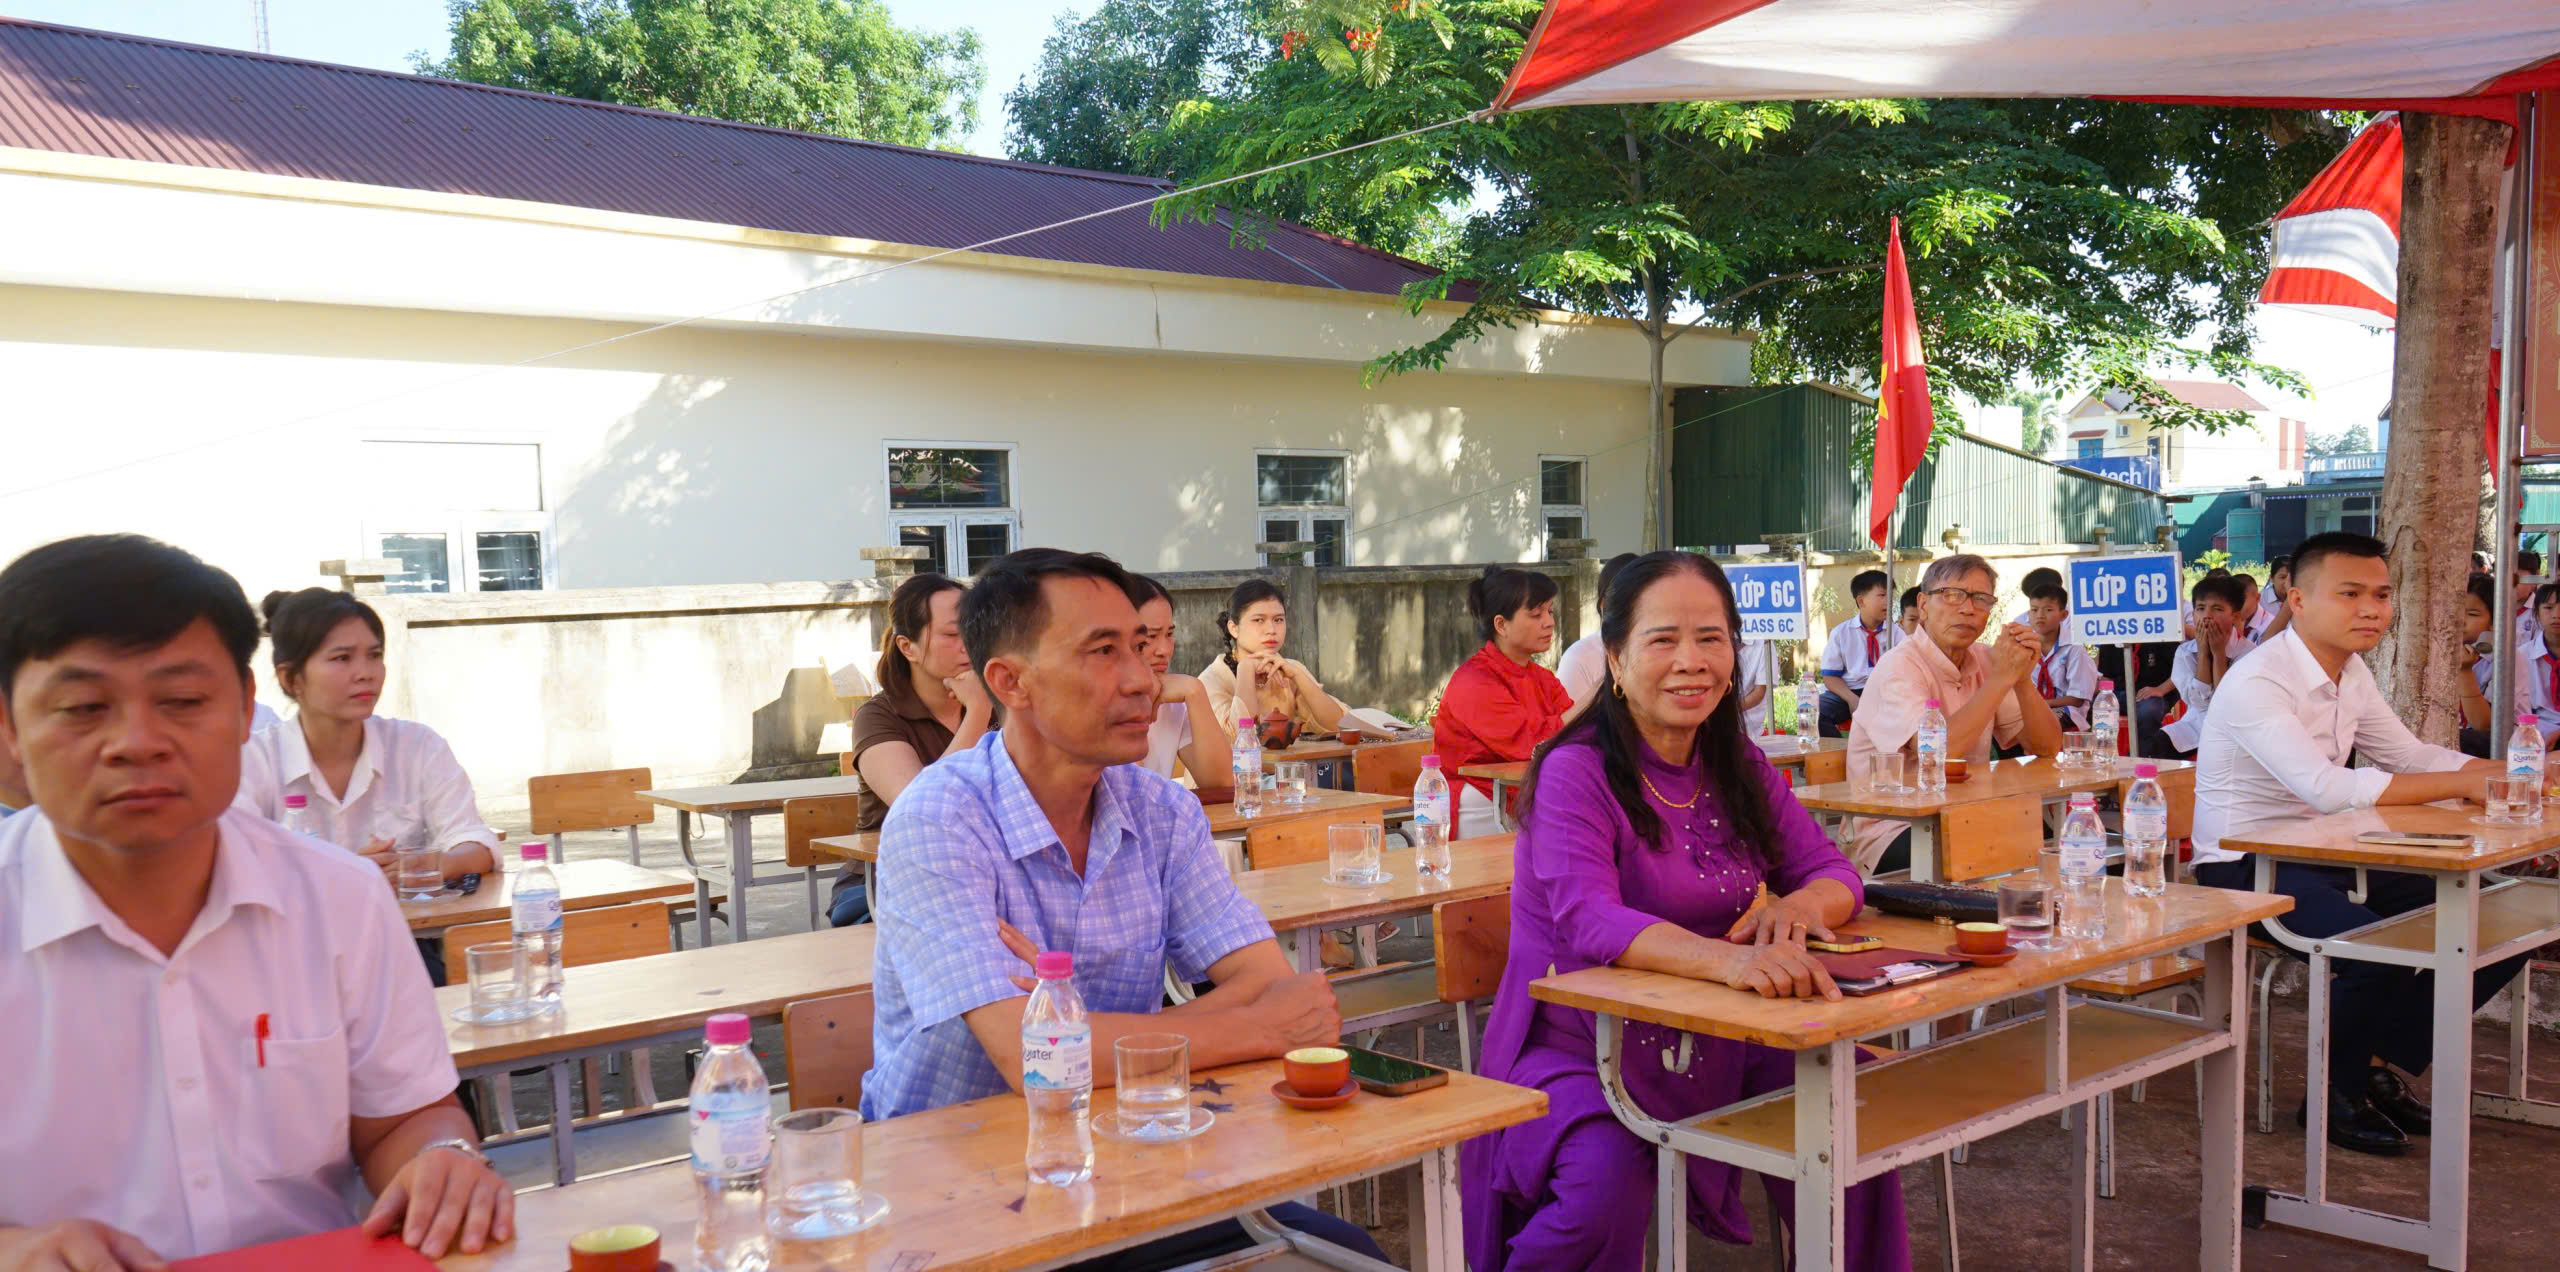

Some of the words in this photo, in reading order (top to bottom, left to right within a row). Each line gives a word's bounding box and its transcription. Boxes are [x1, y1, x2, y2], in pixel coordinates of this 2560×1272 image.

[1771, 580, 1796, 608] 6C
[2080, 567, 2127, 608] LỚP
[2134, 573, 2168, 606] 6B
[1741, 618, 1775, 633] LASS
[1778, 618, 1794, 633] 6C
[2084, 618, 2139, 637] CLASS
[2143, 617, 2165, 635] 6B
